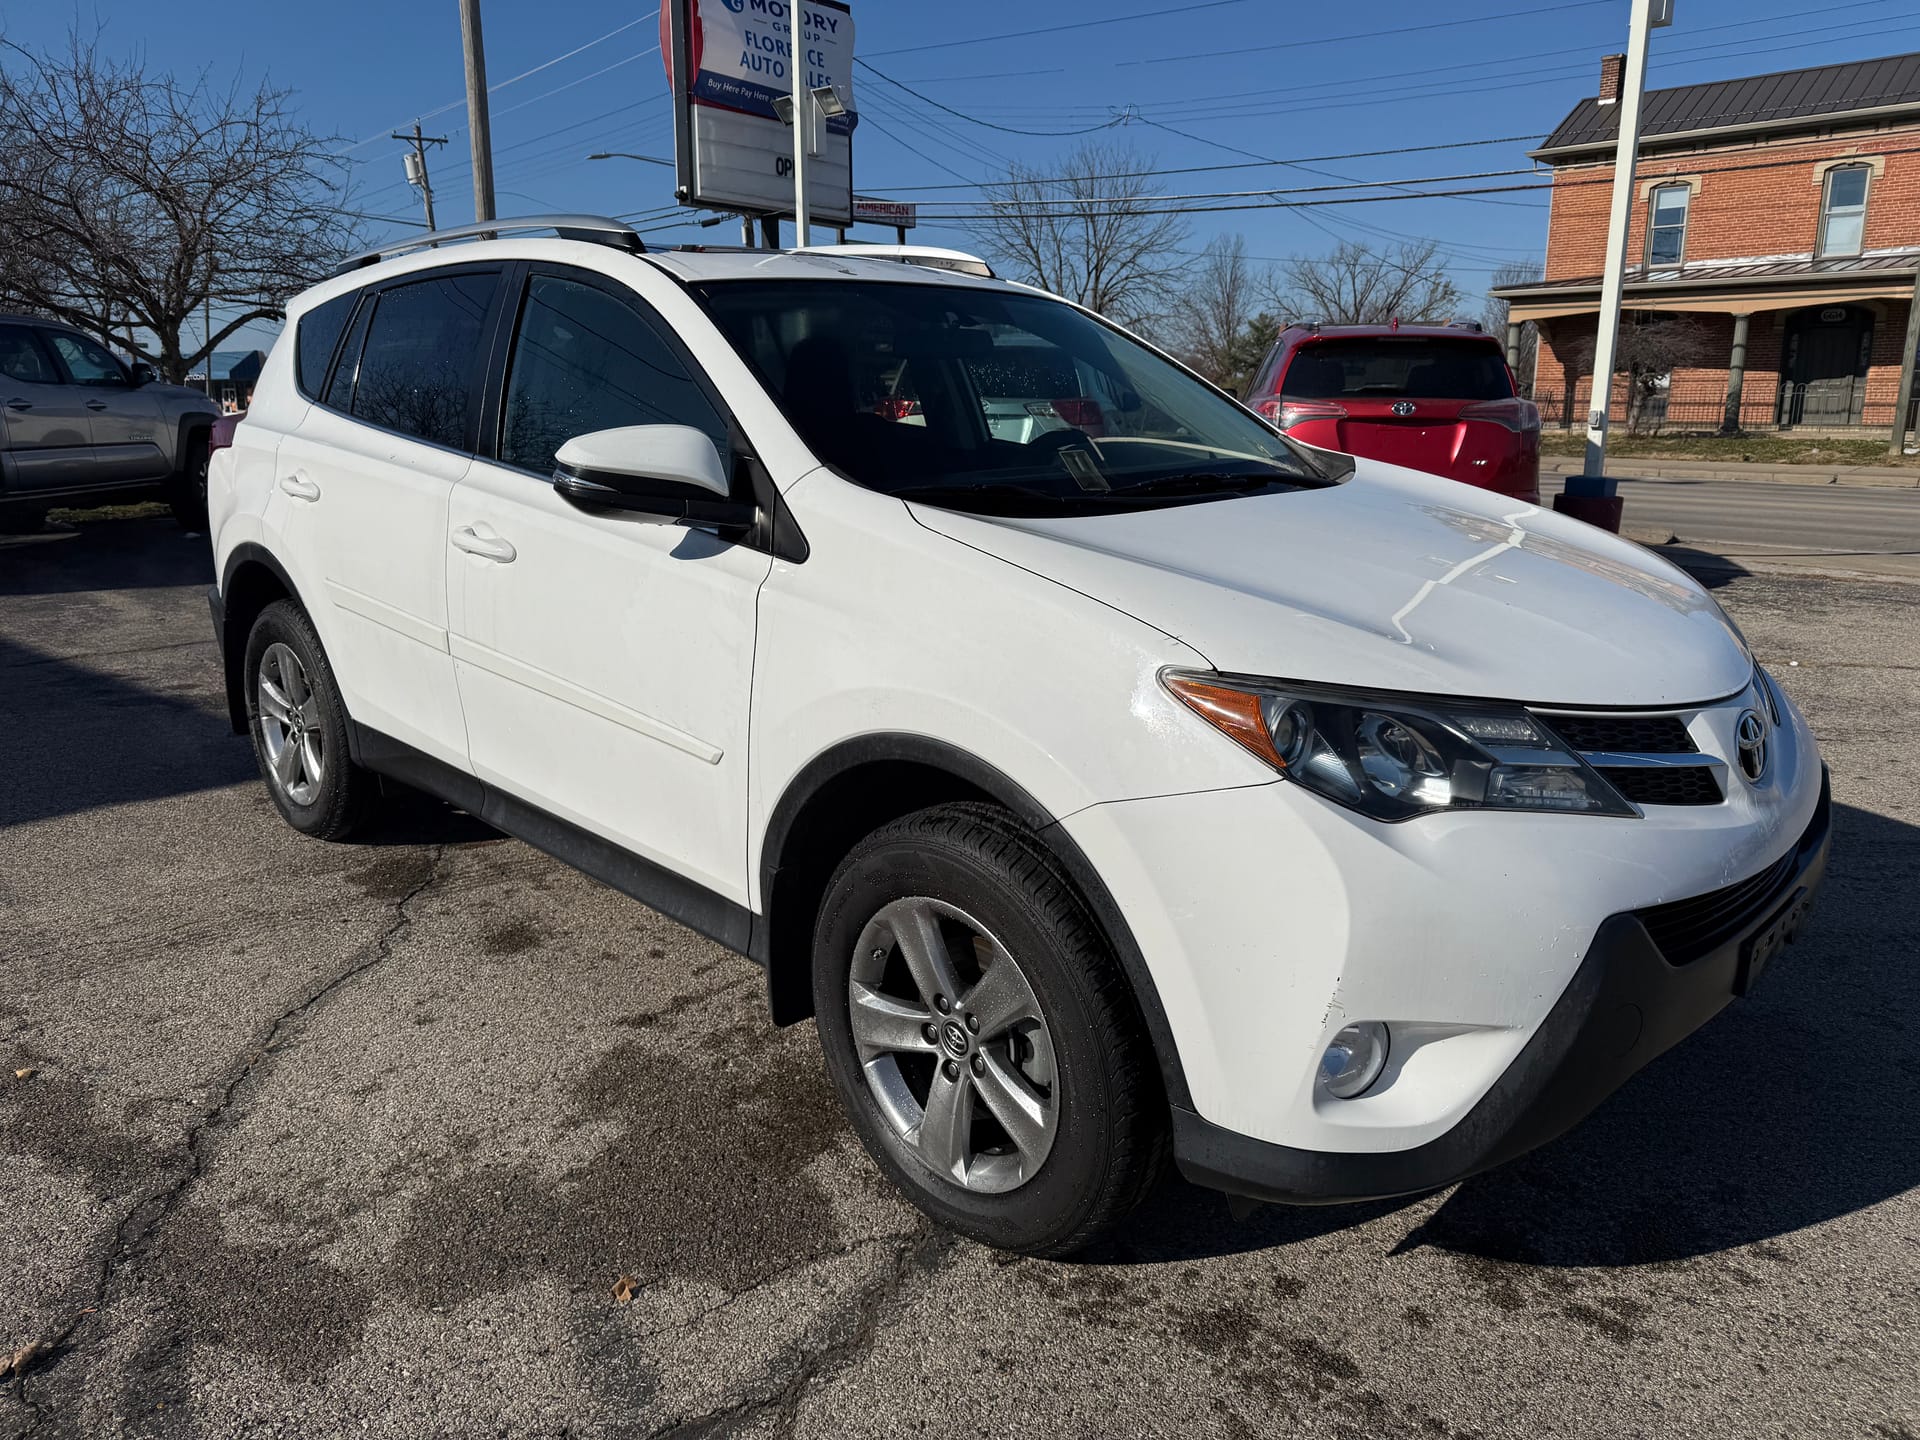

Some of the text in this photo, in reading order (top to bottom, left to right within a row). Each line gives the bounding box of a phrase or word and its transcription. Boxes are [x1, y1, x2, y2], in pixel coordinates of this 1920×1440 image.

[772, 22, 821, 42] GRUP
[745, 31, 823, 68] FLORECE
[739, 52, 832, 88] AUTO LES
[707, 78, 769, 102] Buy Here Pay Here
[857, 203, 909, 216] AMERICAN
